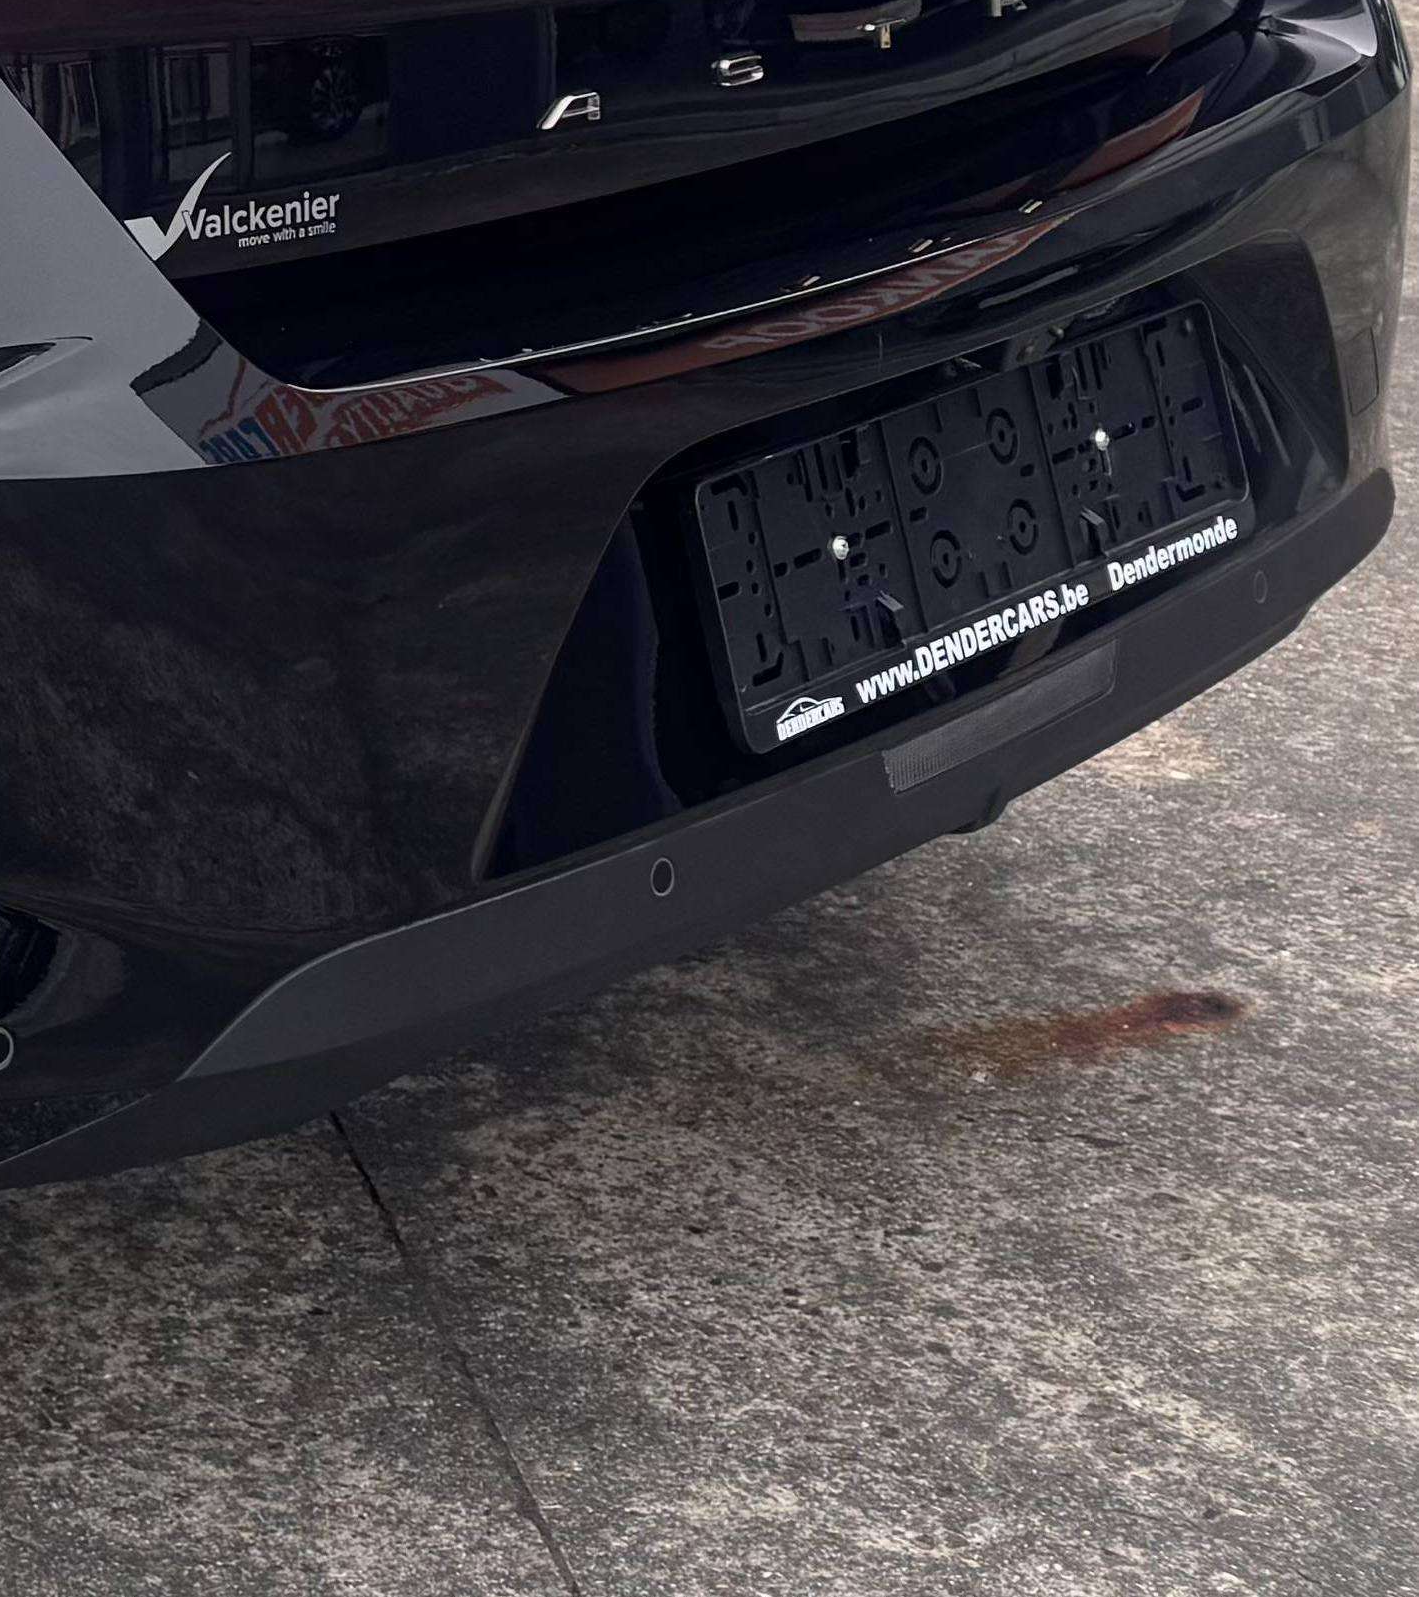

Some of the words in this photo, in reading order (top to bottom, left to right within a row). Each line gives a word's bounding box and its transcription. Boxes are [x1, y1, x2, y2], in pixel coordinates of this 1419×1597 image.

[182, 191, 340, 240] Valckenier
[238, 234, 271, 248] move
[272, 226, 297, 243] with
[298, 227, 306, 239] a
[308, 220, 337, 237] smile
[856, 582, 1090, 704] www.DENDERCARS.be
[1107, 515, 1238, 591] Dendermonde
